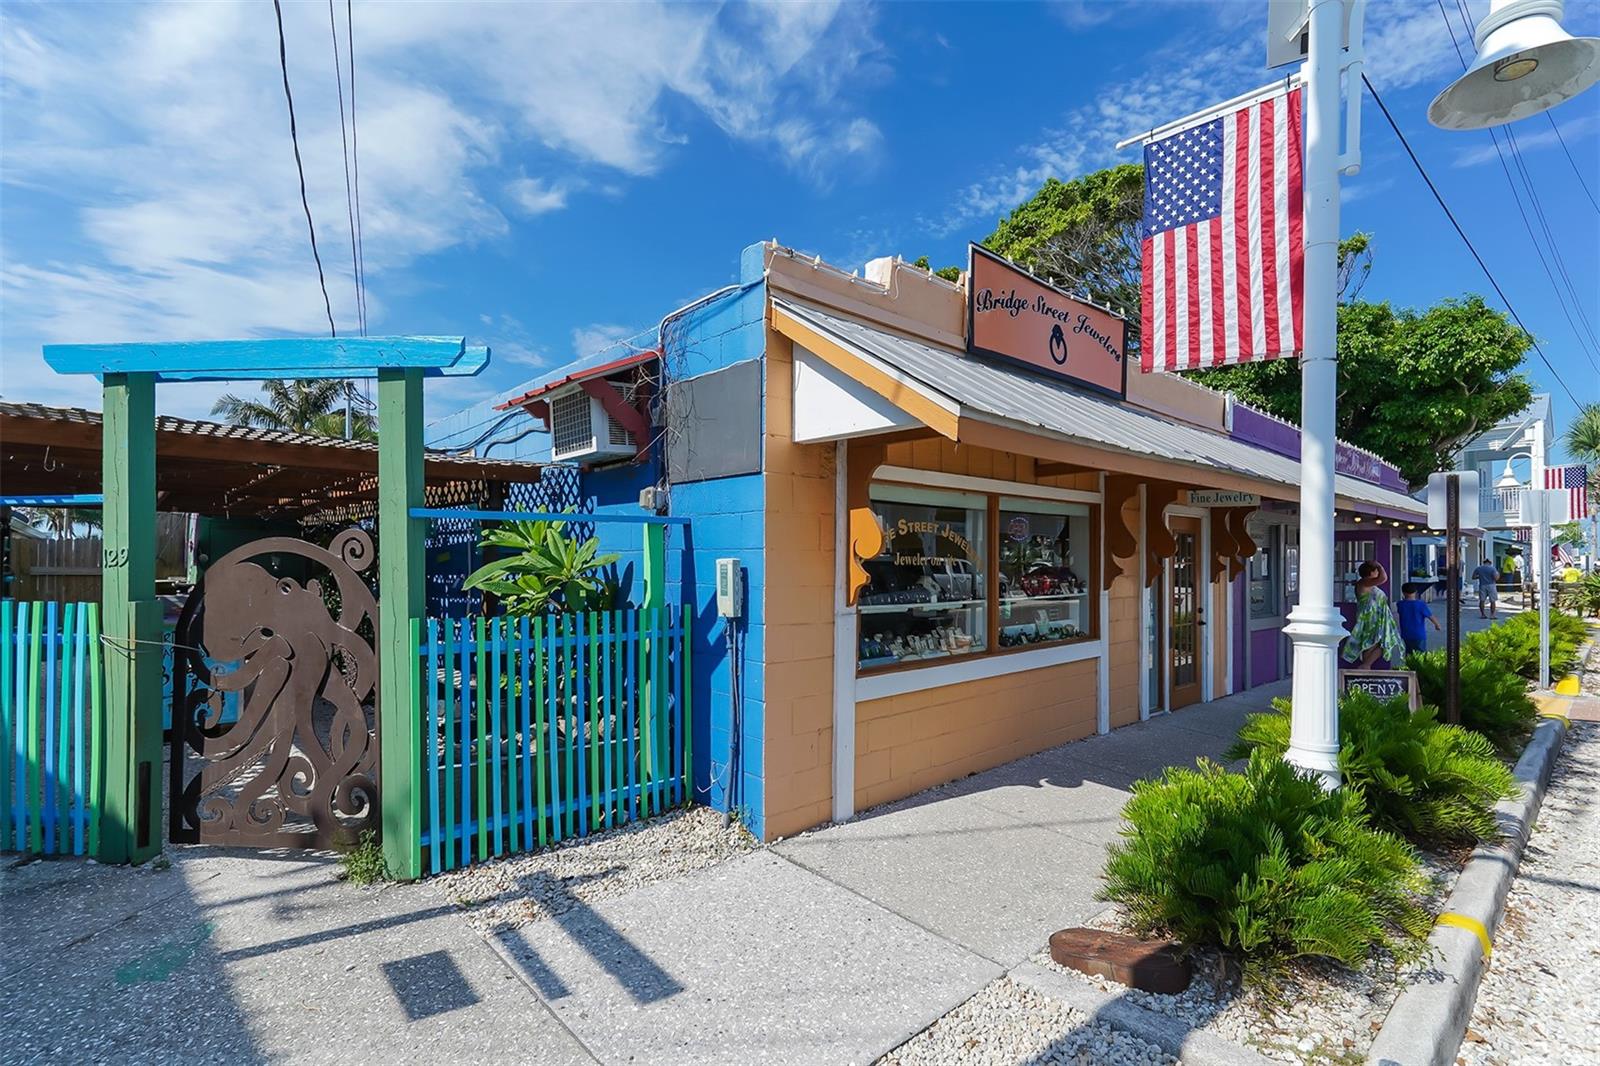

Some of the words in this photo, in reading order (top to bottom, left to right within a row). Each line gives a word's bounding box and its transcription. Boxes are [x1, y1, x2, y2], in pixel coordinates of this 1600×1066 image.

[976, 289, 1029, 317] Bridge
[1032, 295, 1070, 323] Street
[1073, 314, 1121, 362] Jewelers
[1190, 493, 1212, 504] Fine
[1213, 492, 1254, 504] Jewelry
[104, 548, 129, 568] 129
[894, 552, 927, 566] Jeweler
